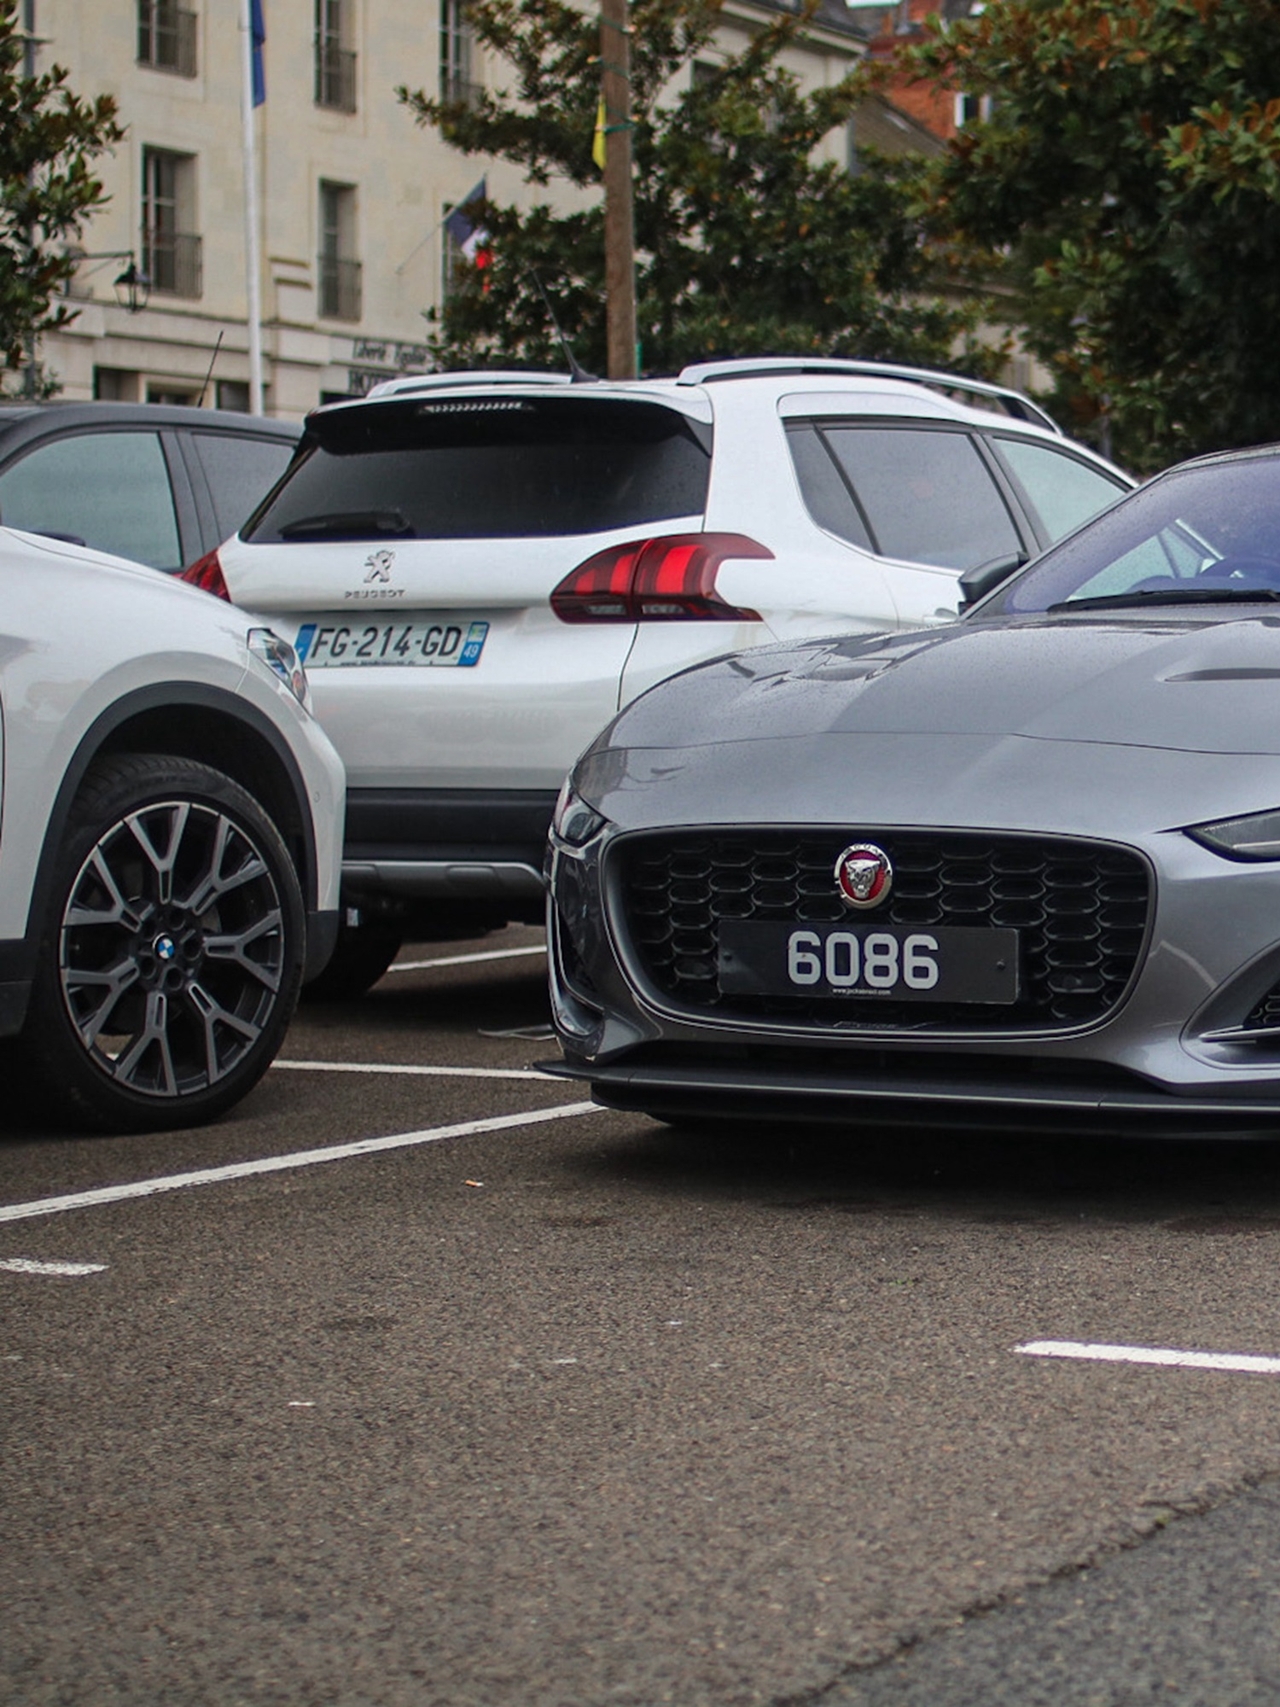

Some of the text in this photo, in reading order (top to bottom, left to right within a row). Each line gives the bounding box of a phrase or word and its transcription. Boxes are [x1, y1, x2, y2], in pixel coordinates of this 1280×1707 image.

[344, 589, 405, 599] PEUGEOT
[310, 625, 480, 659] FG-214-GD 49
[787, 930, 939, 990] 6086
